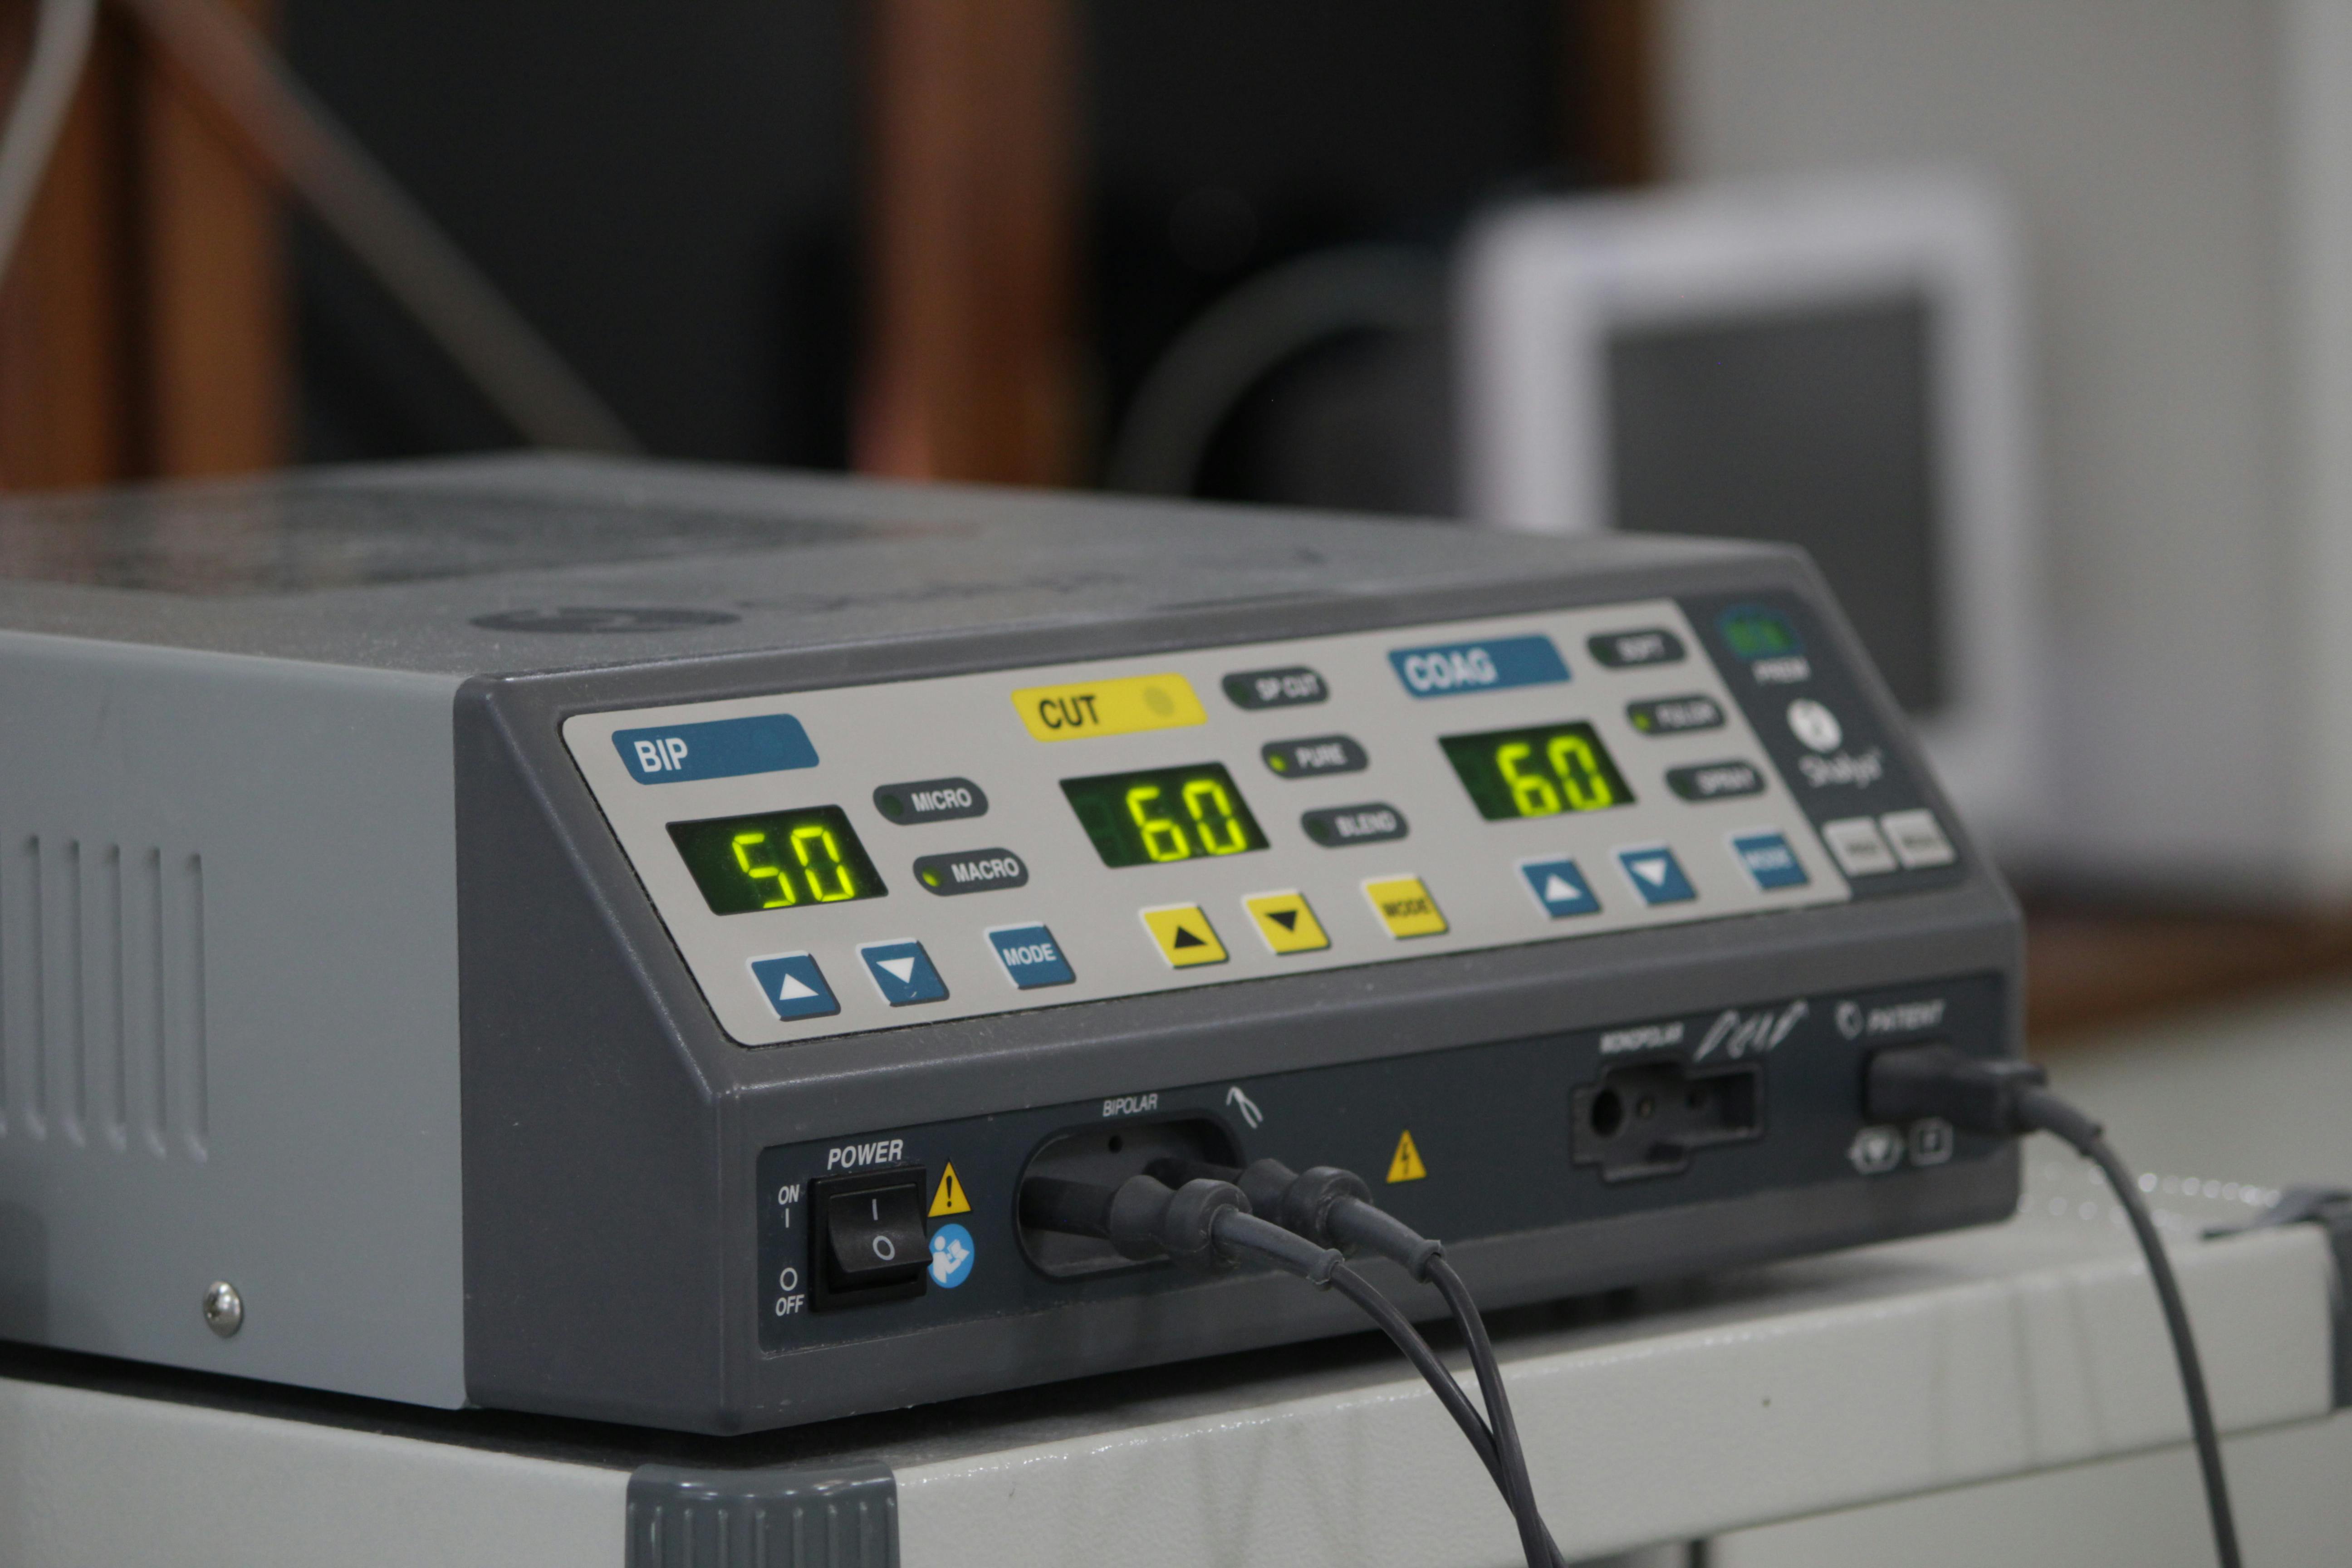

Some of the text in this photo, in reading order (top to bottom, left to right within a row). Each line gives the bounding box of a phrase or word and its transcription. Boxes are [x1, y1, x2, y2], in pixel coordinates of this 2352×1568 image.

[1404, 648, 1499, 691] COAG
[1286, 676, 1320, 697] CUT
[1038, 695, 1101, 730] CUT
[634, 737, 688, 773] BIP
[1295, 743, 1345, 768] PURE
[1494, 735, 1613, 817] 60
[911, 787, 972, 813] MICRO
[1125, 779, 1248, 862] 60
[1336, 812, 1397, 837] BLEND
[731, 826, 855, 909] 50
[951, 857, 1020, 884] MACRO
[1381, 898, 1432, 919] MODE
[1004, 943, 1057, 968] MODE
[1102, 1093, 1158, 1117] BIPOLAR
[827, 1139, 904, 1171] POWER
[778, 1185, 800, 1205] ON
[775, 1294, 805, 1317] OFF
